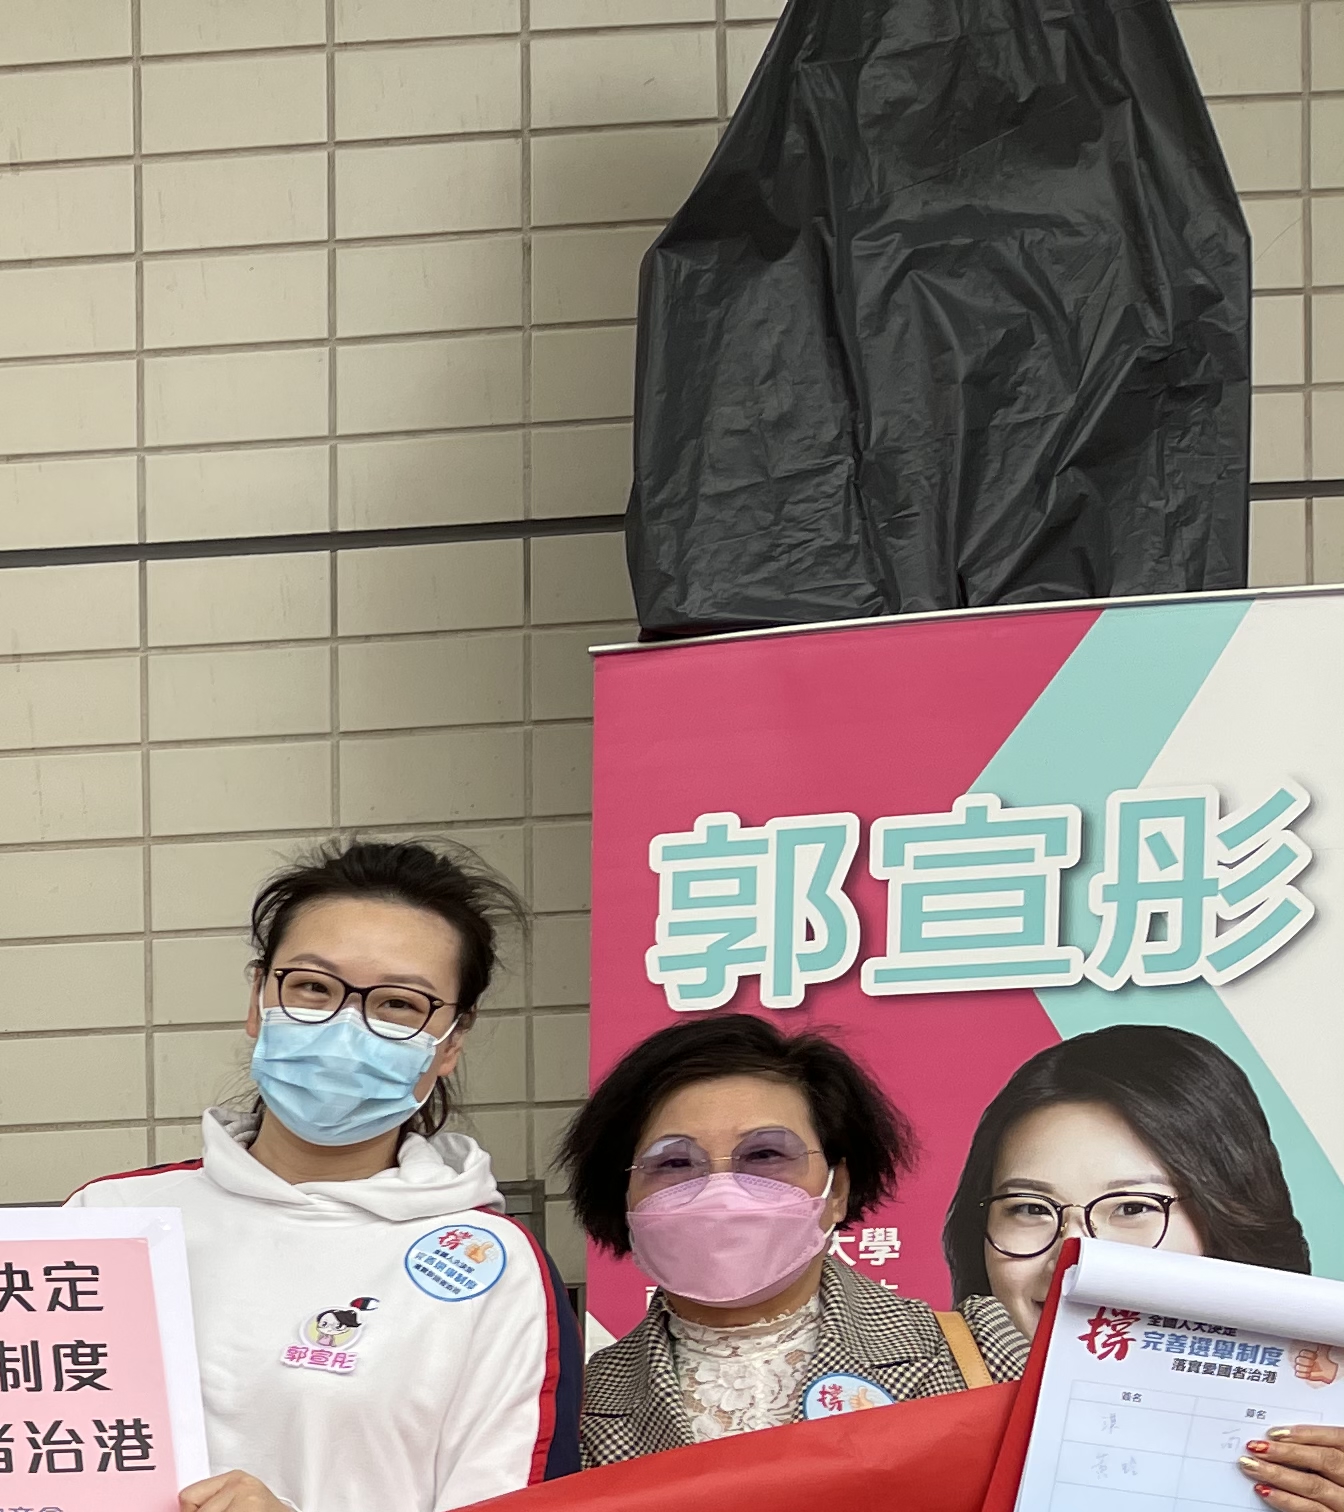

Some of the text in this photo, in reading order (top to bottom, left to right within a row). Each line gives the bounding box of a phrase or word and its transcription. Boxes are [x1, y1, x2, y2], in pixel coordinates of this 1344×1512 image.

[654, 786, 1309, 1004] 郭宣彤
[1141, 1330, 1285, 1368] 完善選舉制度
